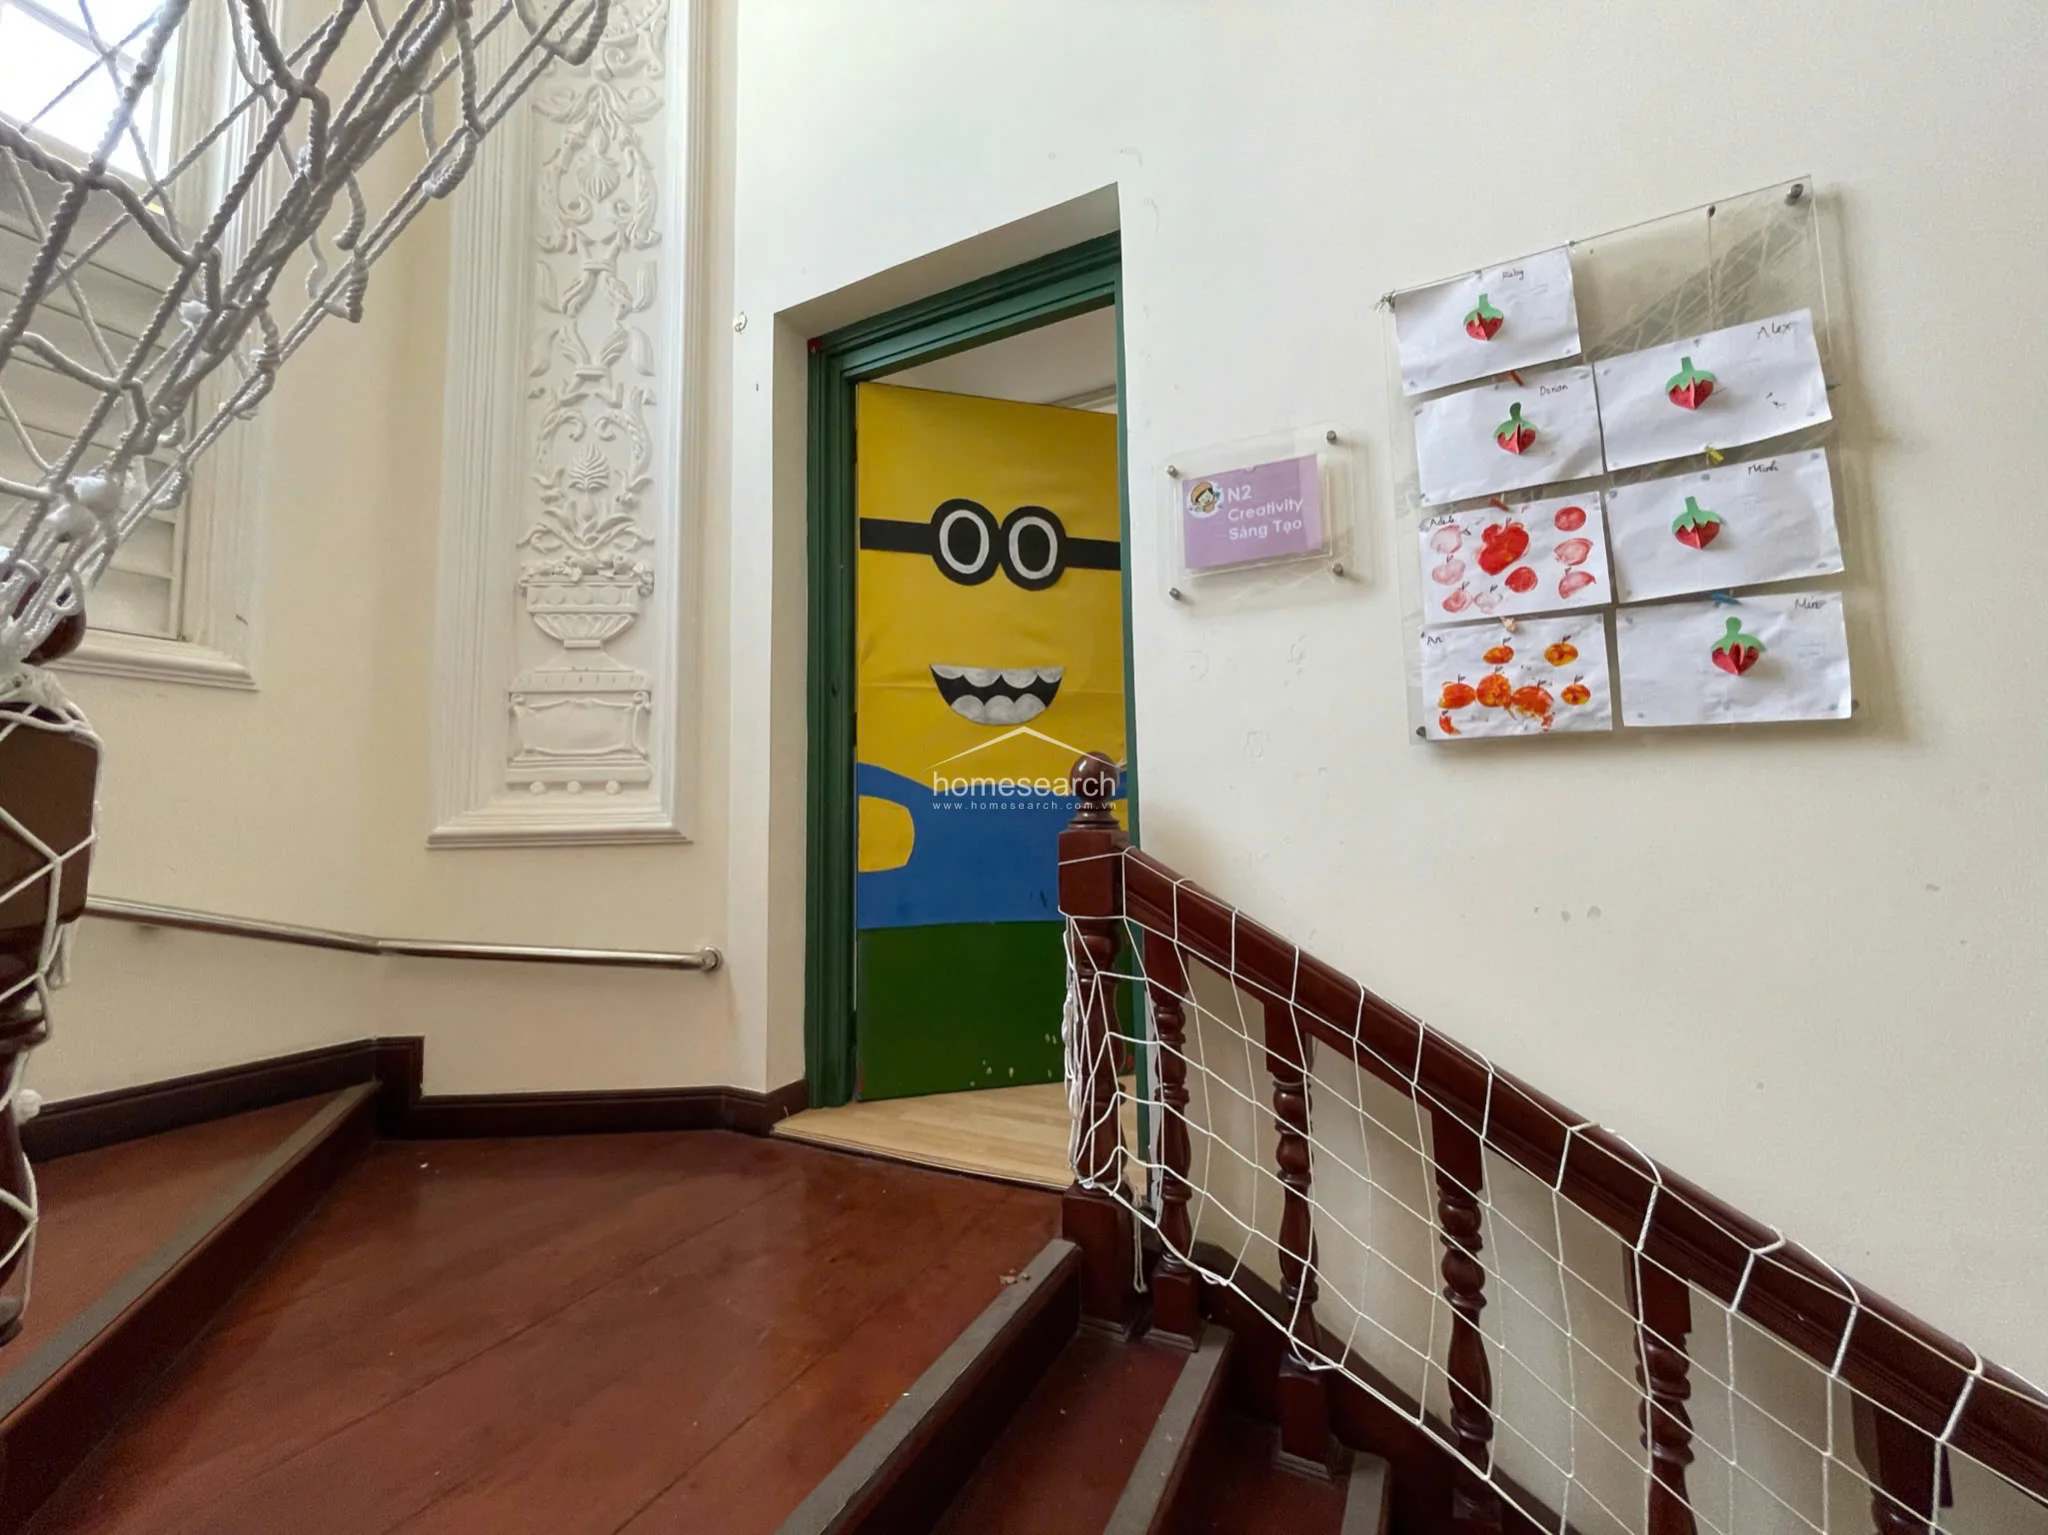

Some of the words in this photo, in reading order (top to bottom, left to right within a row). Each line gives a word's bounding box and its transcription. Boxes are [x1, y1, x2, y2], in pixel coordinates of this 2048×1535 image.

[1756, 321, 1792, 341] Alex
[1228, 485, 1252, 503] N2
[1228, 498, 1303, 522] Creativity
[1229, 524, 1268, 540] Sáng
[1273, 519, 1303, 535] Tạo
